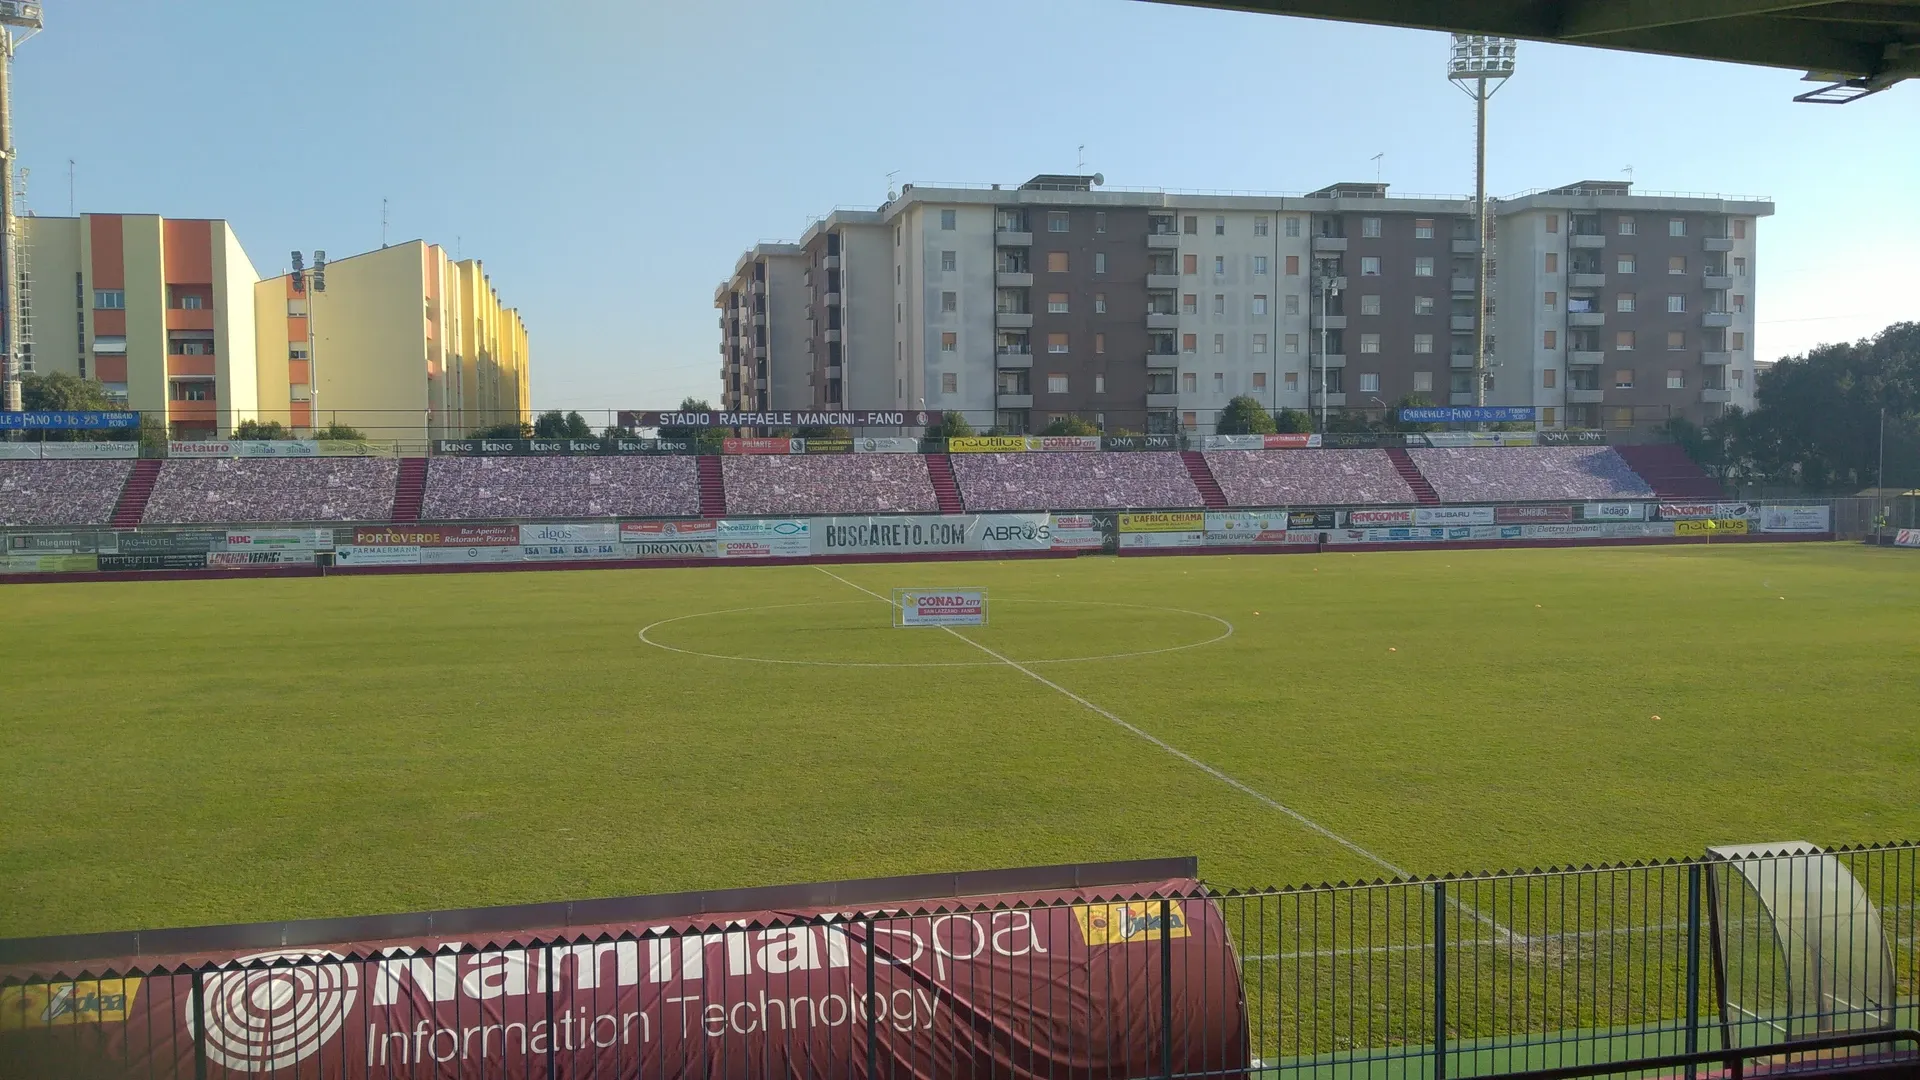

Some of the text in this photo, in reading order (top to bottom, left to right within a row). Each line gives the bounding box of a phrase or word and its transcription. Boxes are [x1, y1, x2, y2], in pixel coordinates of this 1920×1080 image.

[659, 412, 710, 425] STADIO
[719, 412, 792, 425] RAFFAELE
[797, 412, 855, 425] MANCINI
[867, 412, 904, 425] FANO
[1452, 408, 1472, 420] FANO
[23, 413, 51, 427] FANO
[953, 438, 1022, 447] nautilus
[1043, 437, 1081, 447] CONAD
[1110, 437, 1169, 446] DNA DNA
[100, 444, 136, 452] GRAFICA
[171, 443, 229, 453] Metauro
[1518, 508, 1548, 517] SAMBUGA
[1134, 513, 1202, 523] L'AFRICA CHIAMA
[476, 528, 507, 536] Aperitivi
[538, 526, 572, 542] algos
[826, 523, 965, 548] BUSCARETO.COM
[228, 535, 251, 544] RDC
[357, 533, 440, 543] PORTOVERDE
[485, 535, 517, 543] Pizzeria
[550, 546, 564, 554] ISA
[574, 546, 588, 554] ISA
[599, 545, 613, 553] ISA
[636, 543, 704, 555] IDRONOVA
[727, 542, 758, 550] CONAD
[918, 596, 964, 606] CONAD
[373, 911, 850, 1006] Namirial
[367, 982, 941, 1067] Information Technology
